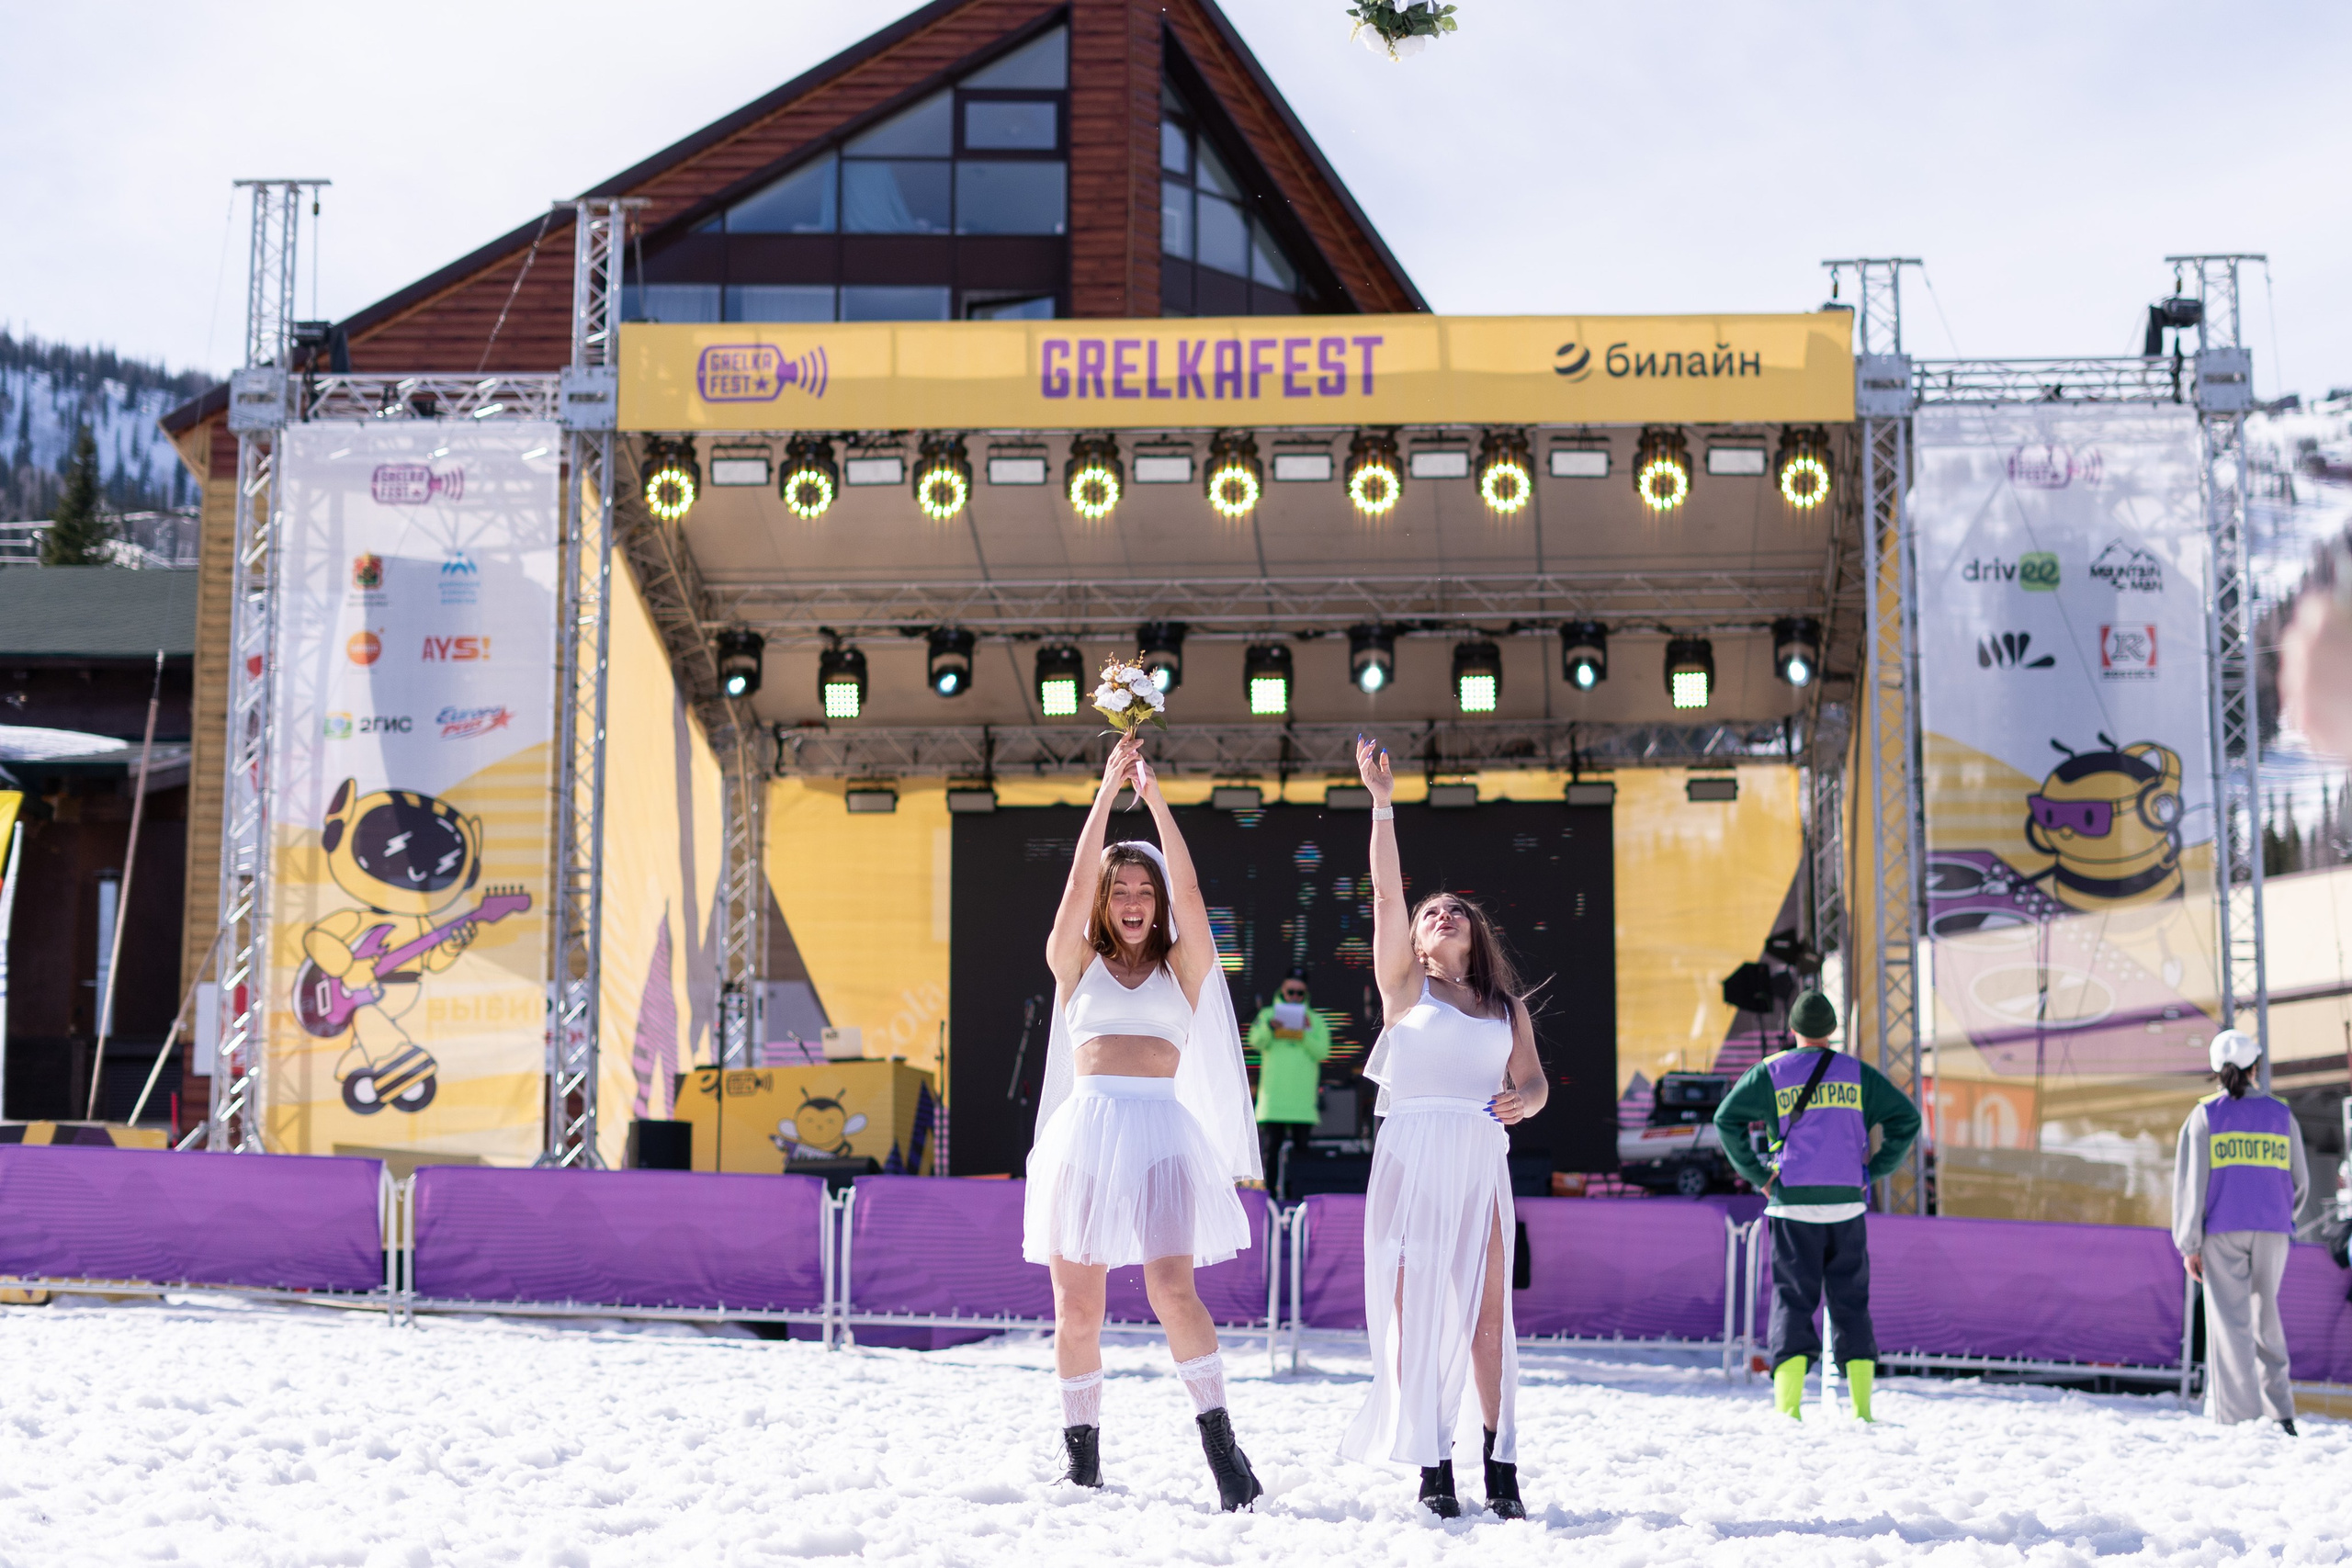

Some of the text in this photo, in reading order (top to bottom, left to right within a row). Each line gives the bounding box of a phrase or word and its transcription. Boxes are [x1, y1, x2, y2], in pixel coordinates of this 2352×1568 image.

[710, 354, 773, 371] GRELKA
[1042, 336, 1384, 399] GRELKAFEST
[1606, 343, 1760, 378] билайн
[710, 376, 751, 393] FEST
[1962, 558, 2060, 584] drivee
[422, 636, 492, 661] AYS!
[359, 716, 413, 734] 2ГИС
[2214, 1137, 2288, 1161] ФОТОГРАФ
